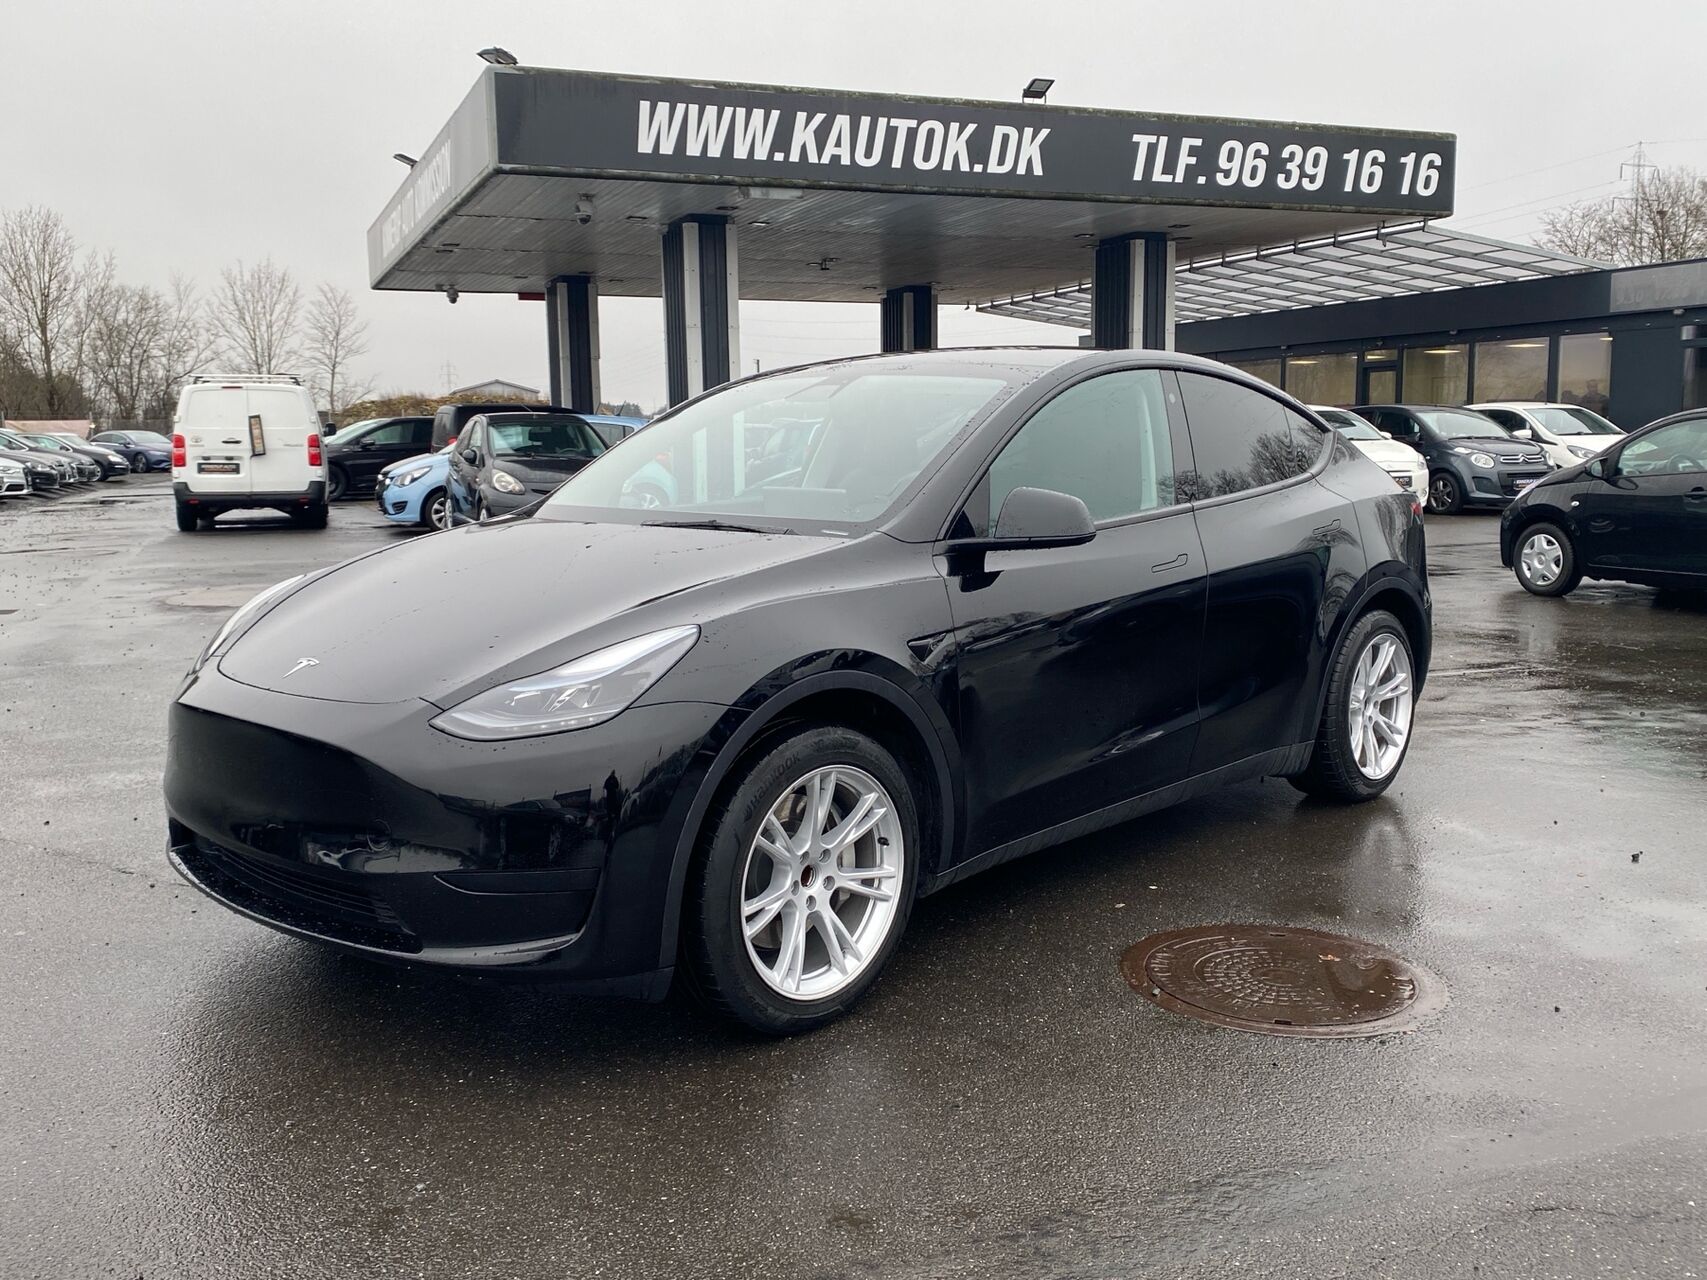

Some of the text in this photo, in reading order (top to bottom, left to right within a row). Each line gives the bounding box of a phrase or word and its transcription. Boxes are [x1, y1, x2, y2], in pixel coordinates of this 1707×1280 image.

[637, 100, 1051, 176] WWW.KAUTOK.DK
[1132, 133, 1443, 197] TLF. 96 39 16 16
